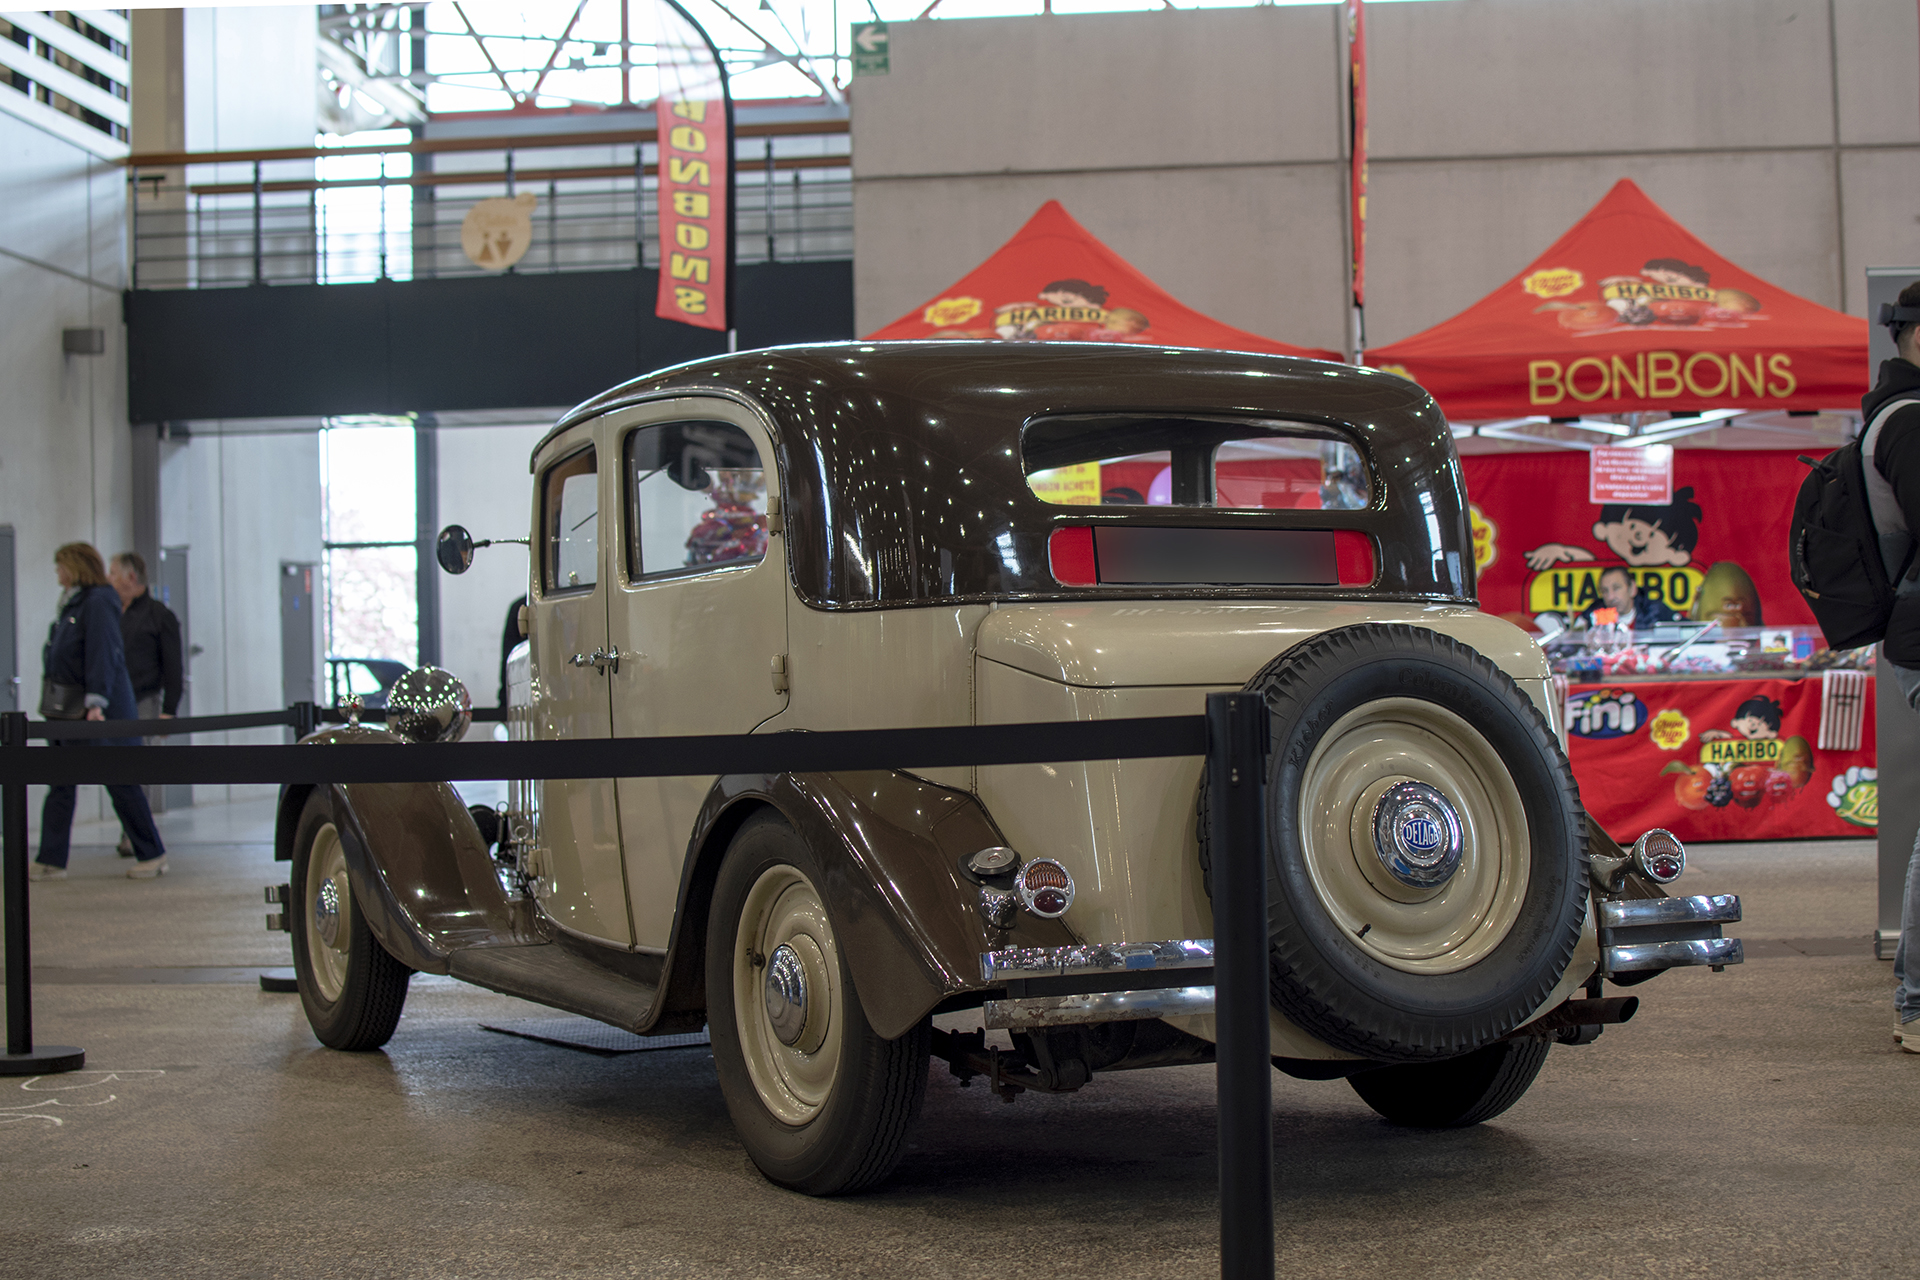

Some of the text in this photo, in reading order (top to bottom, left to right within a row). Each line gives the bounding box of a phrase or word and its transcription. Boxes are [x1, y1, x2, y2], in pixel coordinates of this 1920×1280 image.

[1616, 284, 1711, 300] HARIBO
[1010, 306, 1101, 325] HARIBO
[1528, 351, 1797, 405] BONBONS
[1552, 572, 1689, 606] HABO
[1567, 692, 1637, 734] Fini
[1711, 741, 1778, 760] HARIBO
